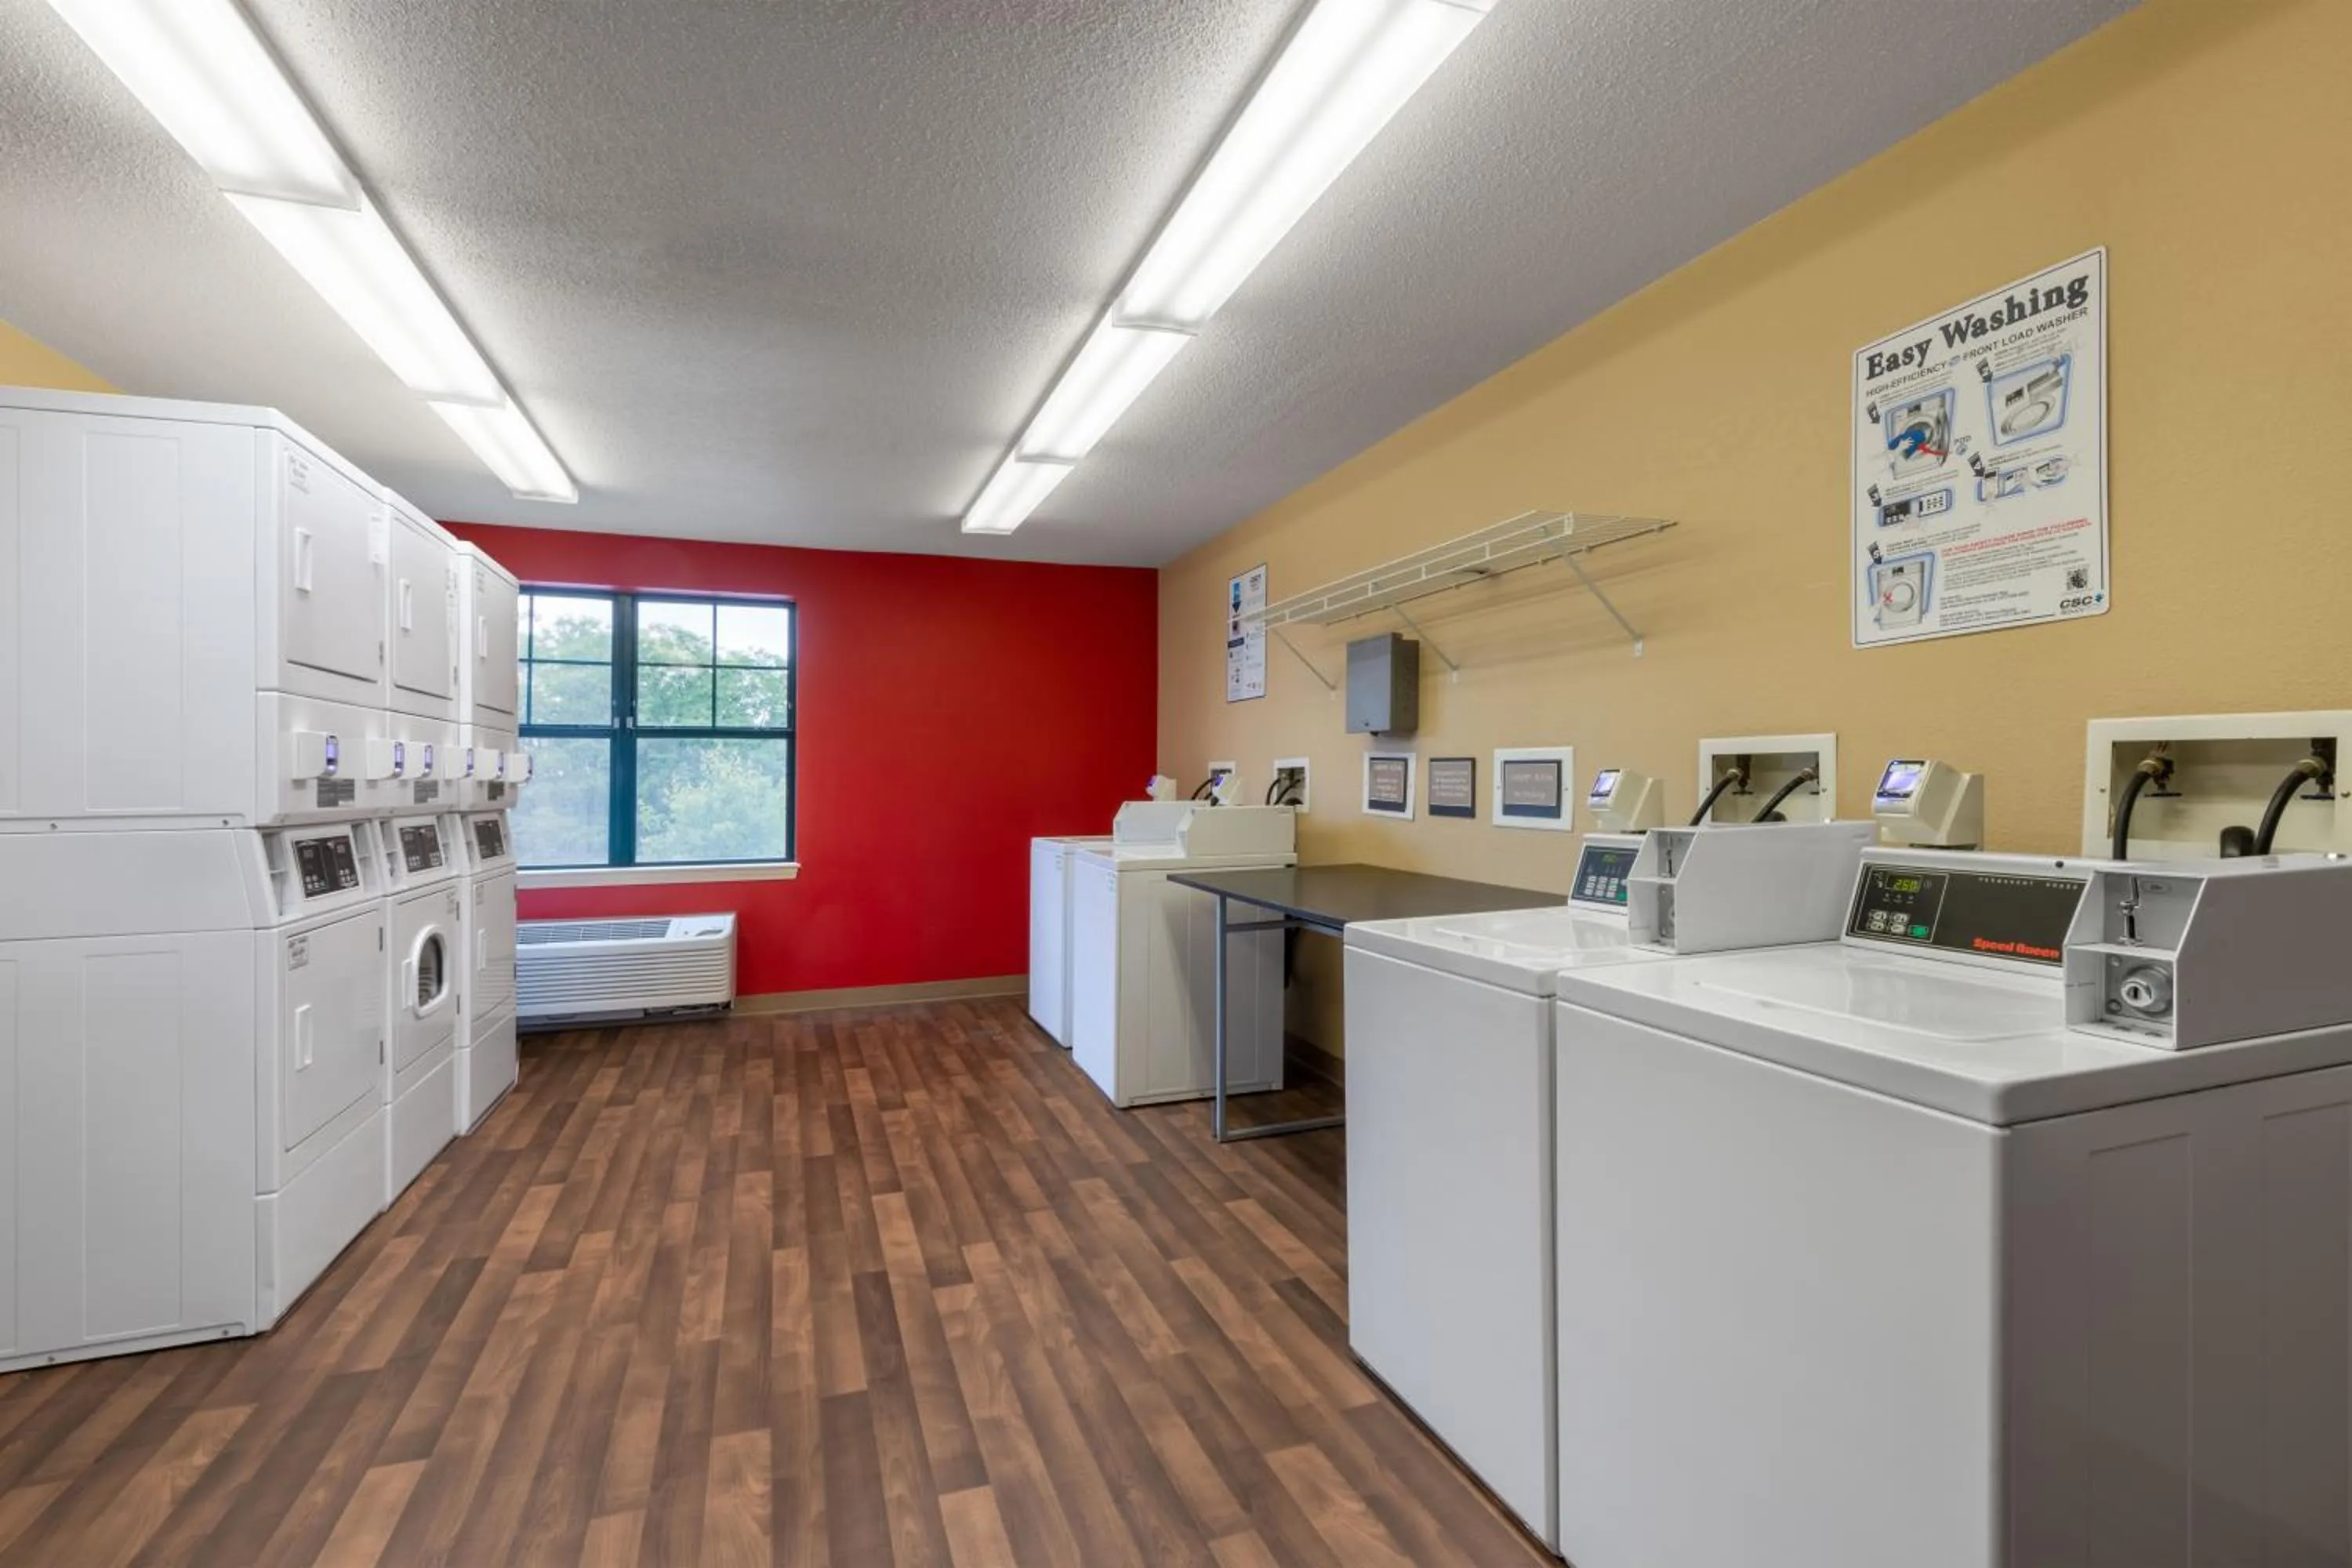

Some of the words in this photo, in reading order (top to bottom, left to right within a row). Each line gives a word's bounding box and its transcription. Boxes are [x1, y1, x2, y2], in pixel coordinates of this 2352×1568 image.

[1866, 338, 1932, 380] Easy
[1939, 274, 2089, 349] Washing
[1962, 341, 1998, 361] FRONT
[2002, 328, 2034, 347] LOAD
[2036, 307, 2089, 333] WASHER
[2060, 595, 2092, 609] CSC
[1973, 937, 2014, 953] Speed
[2016, 943, 2058, 958] Queen
